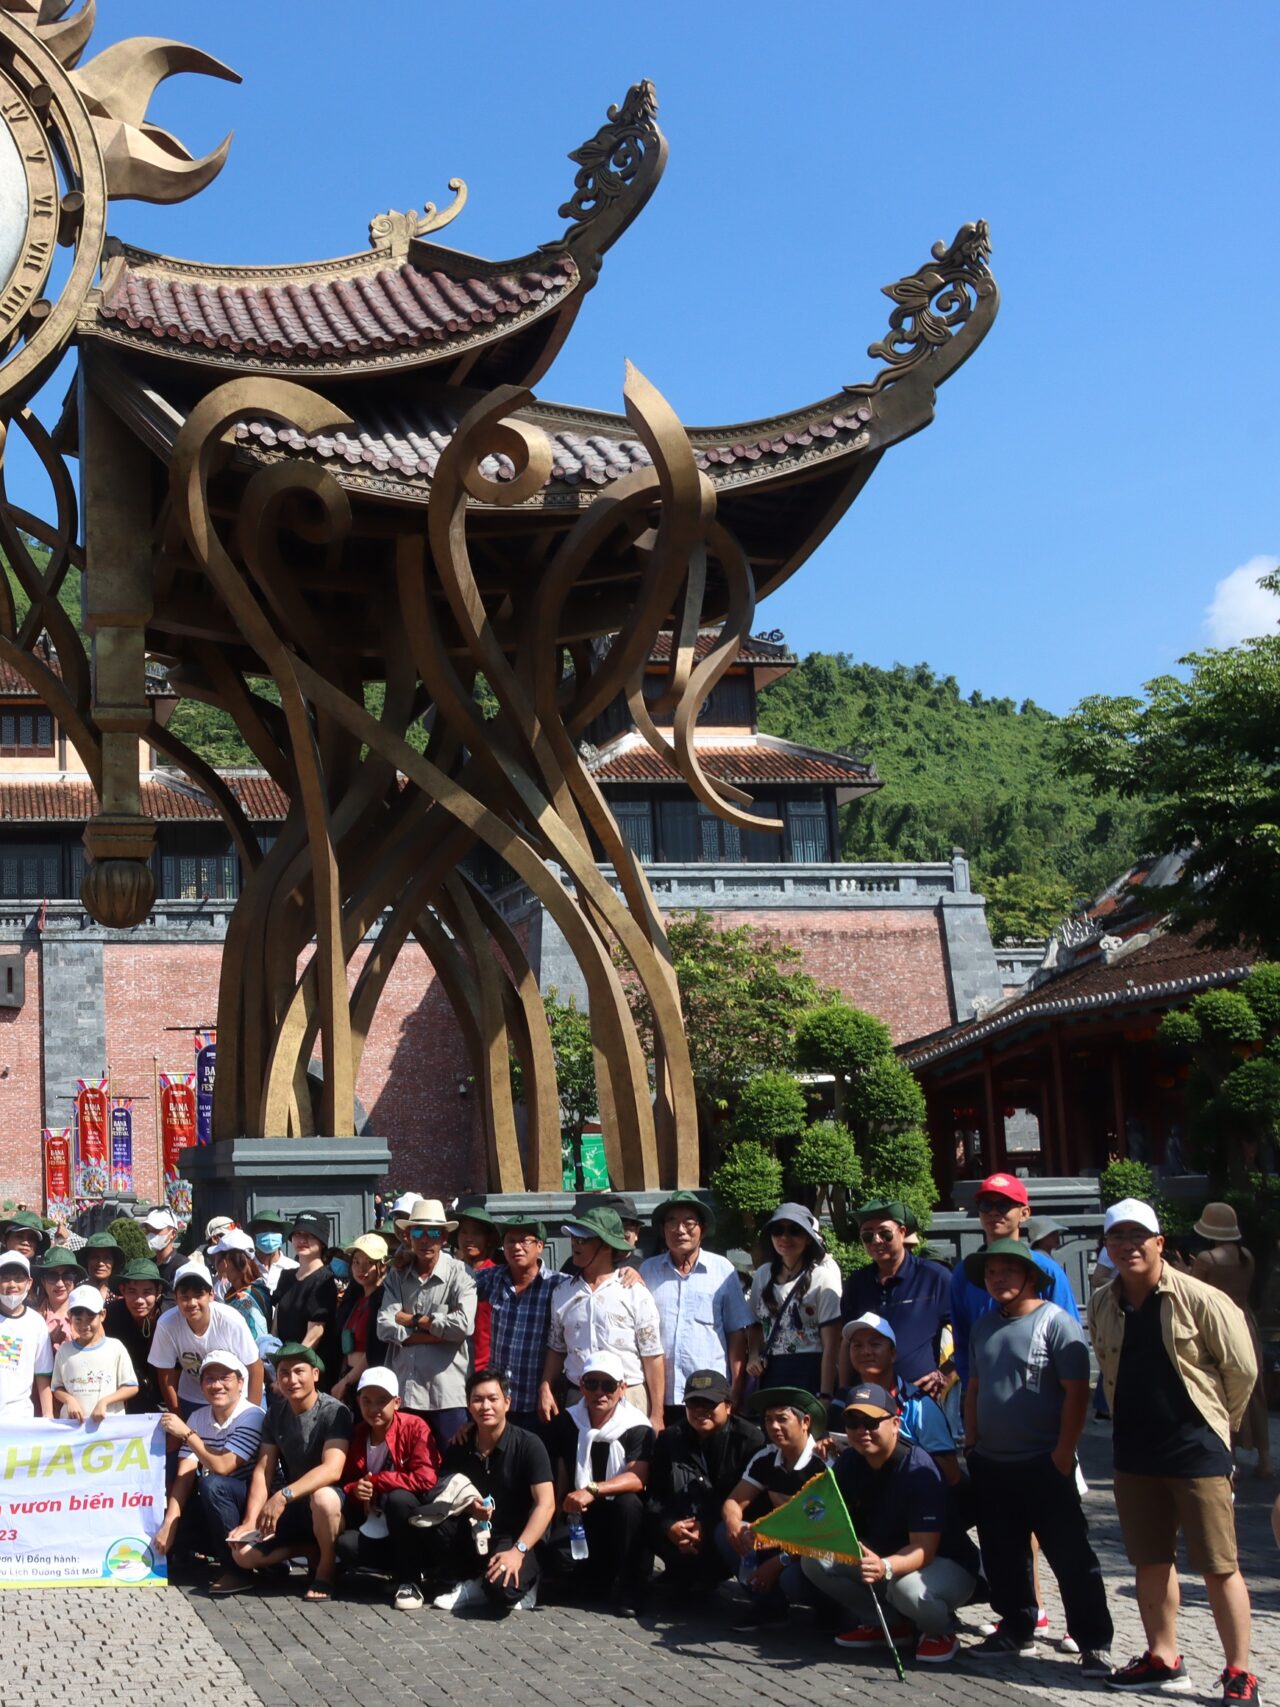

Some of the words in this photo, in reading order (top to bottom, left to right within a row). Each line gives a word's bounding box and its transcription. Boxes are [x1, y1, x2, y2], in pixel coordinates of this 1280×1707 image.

[3, 1437, 150, 1480] HAGA
[9, 1499, 62, 1515] vươn
[69, 1491, 114, 1511] biển
[121, 1492, 154, 1508] lớn
